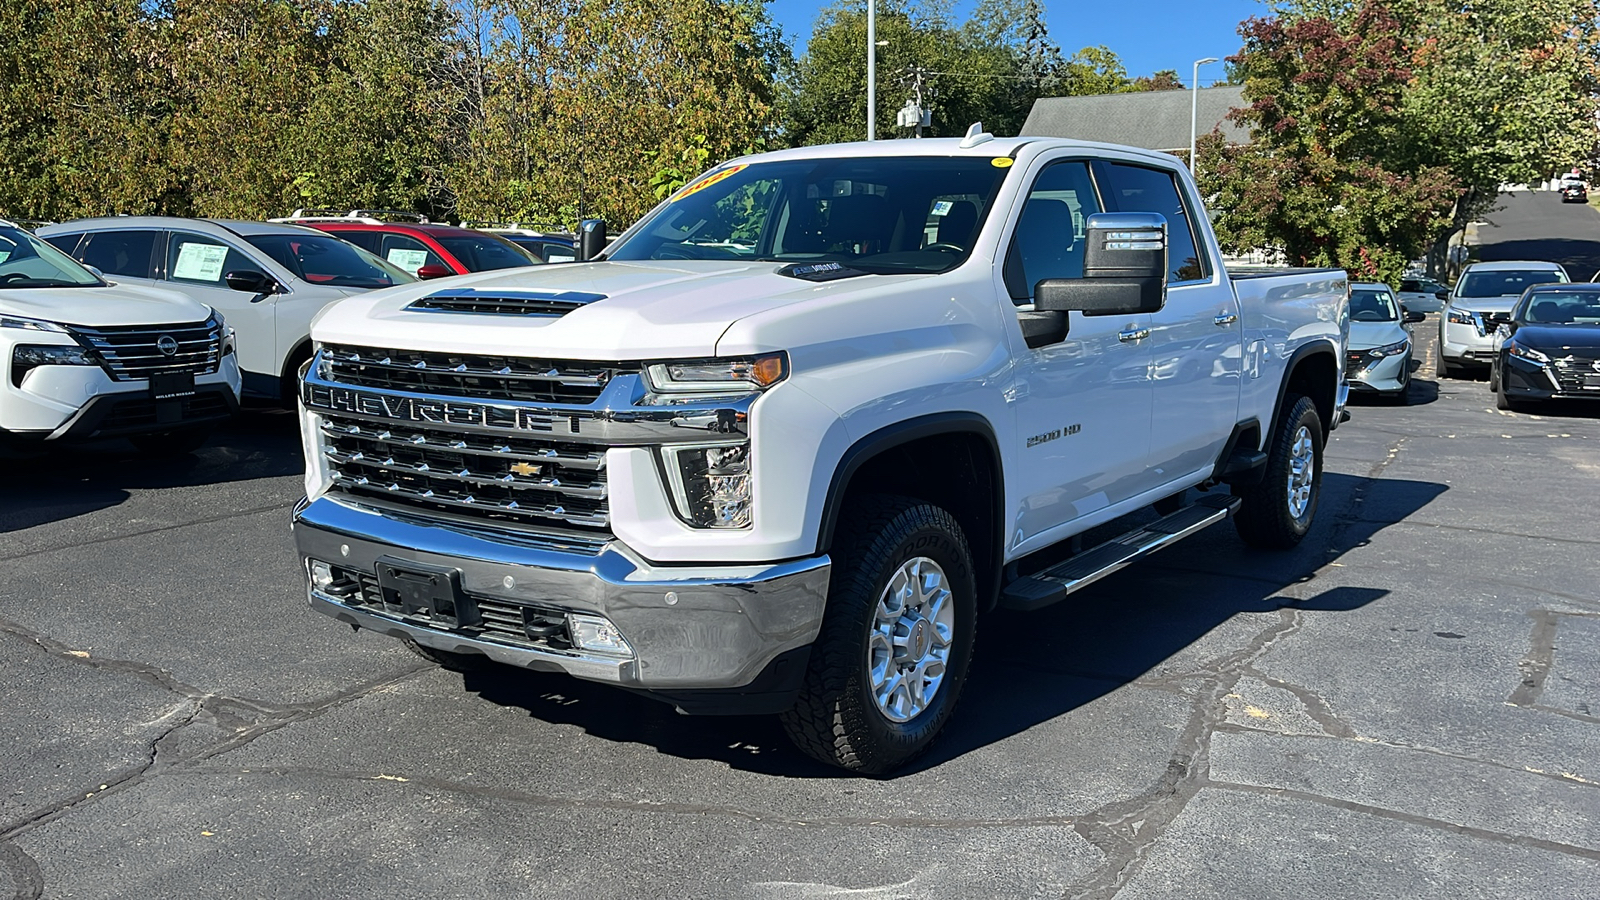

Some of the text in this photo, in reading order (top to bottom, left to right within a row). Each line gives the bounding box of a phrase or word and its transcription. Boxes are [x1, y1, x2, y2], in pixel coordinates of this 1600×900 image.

[309, 386, 592, 434] CHEVROLET
[1026, 423, 1081, 448] 2500 HD
